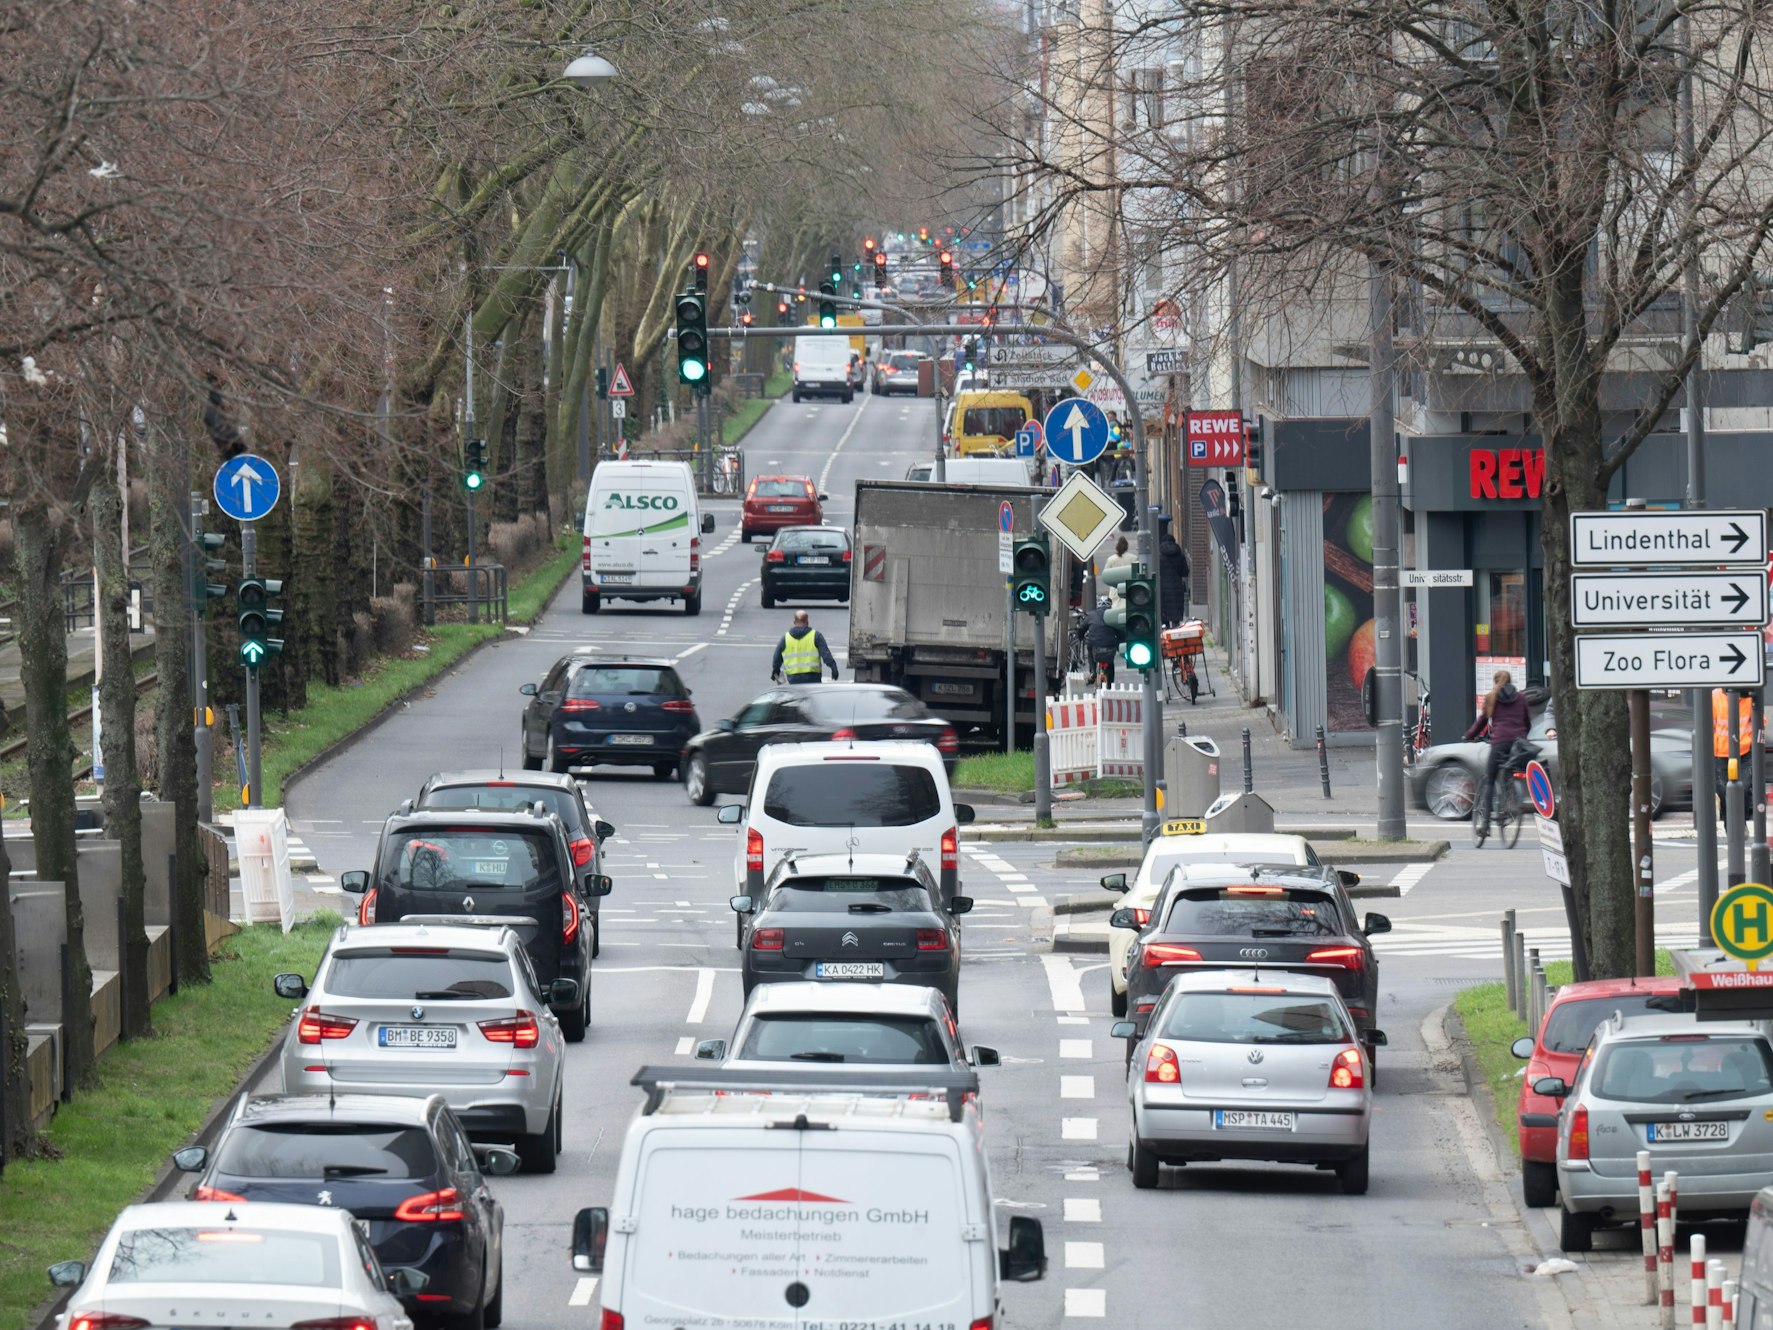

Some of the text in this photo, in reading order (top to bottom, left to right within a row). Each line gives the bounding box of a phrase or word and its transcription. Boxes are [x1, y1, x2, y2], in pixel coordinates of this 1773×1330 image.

[1151, 351, 1174, 363] Jack
[616, 402, 623, 416] 3
[1190, 418, 1240, 434] REWE
[1020, 433, 1031, 454] P
[1194, 443, 1204, 456] P
[1470, 448, 1545, 499] REW
[604, 493, 678, 510] ALSCO
[1589, 528, 1711, 550] Lindenthal
[1409, 573, 1465, 584] Univsitätsstr.
[1584, 589, 1711, 611] Universität
[1603, 650, 1710, 672] Zoo Flora
[1171, 822, 1198, 832] TAXI
[479, 863, 506, 872] K HU
[1733, 903, 1768, 943] H
[824, 965, 881, 975] KA 0422 HK
[387, 1030, 454, 1042] BM BE 9358
[1224, 1112, 1291, 1126] MSP TA 445
[1655, 1123, 1727, 1138] K LW 3728
[671, 1204, 929, 1224] hage bedachungen GmbH
[740, 1229, 842, 1242] Meisterbetrieb
[678, 1250, 928, 1265] Bedachungen aller Art Zimmererarbeiten
[741, 1266, 870, 1278] Fassaden Notdienst
[644, 1314, 793, 1330] Georgsplatz 2b 50676 Köln
